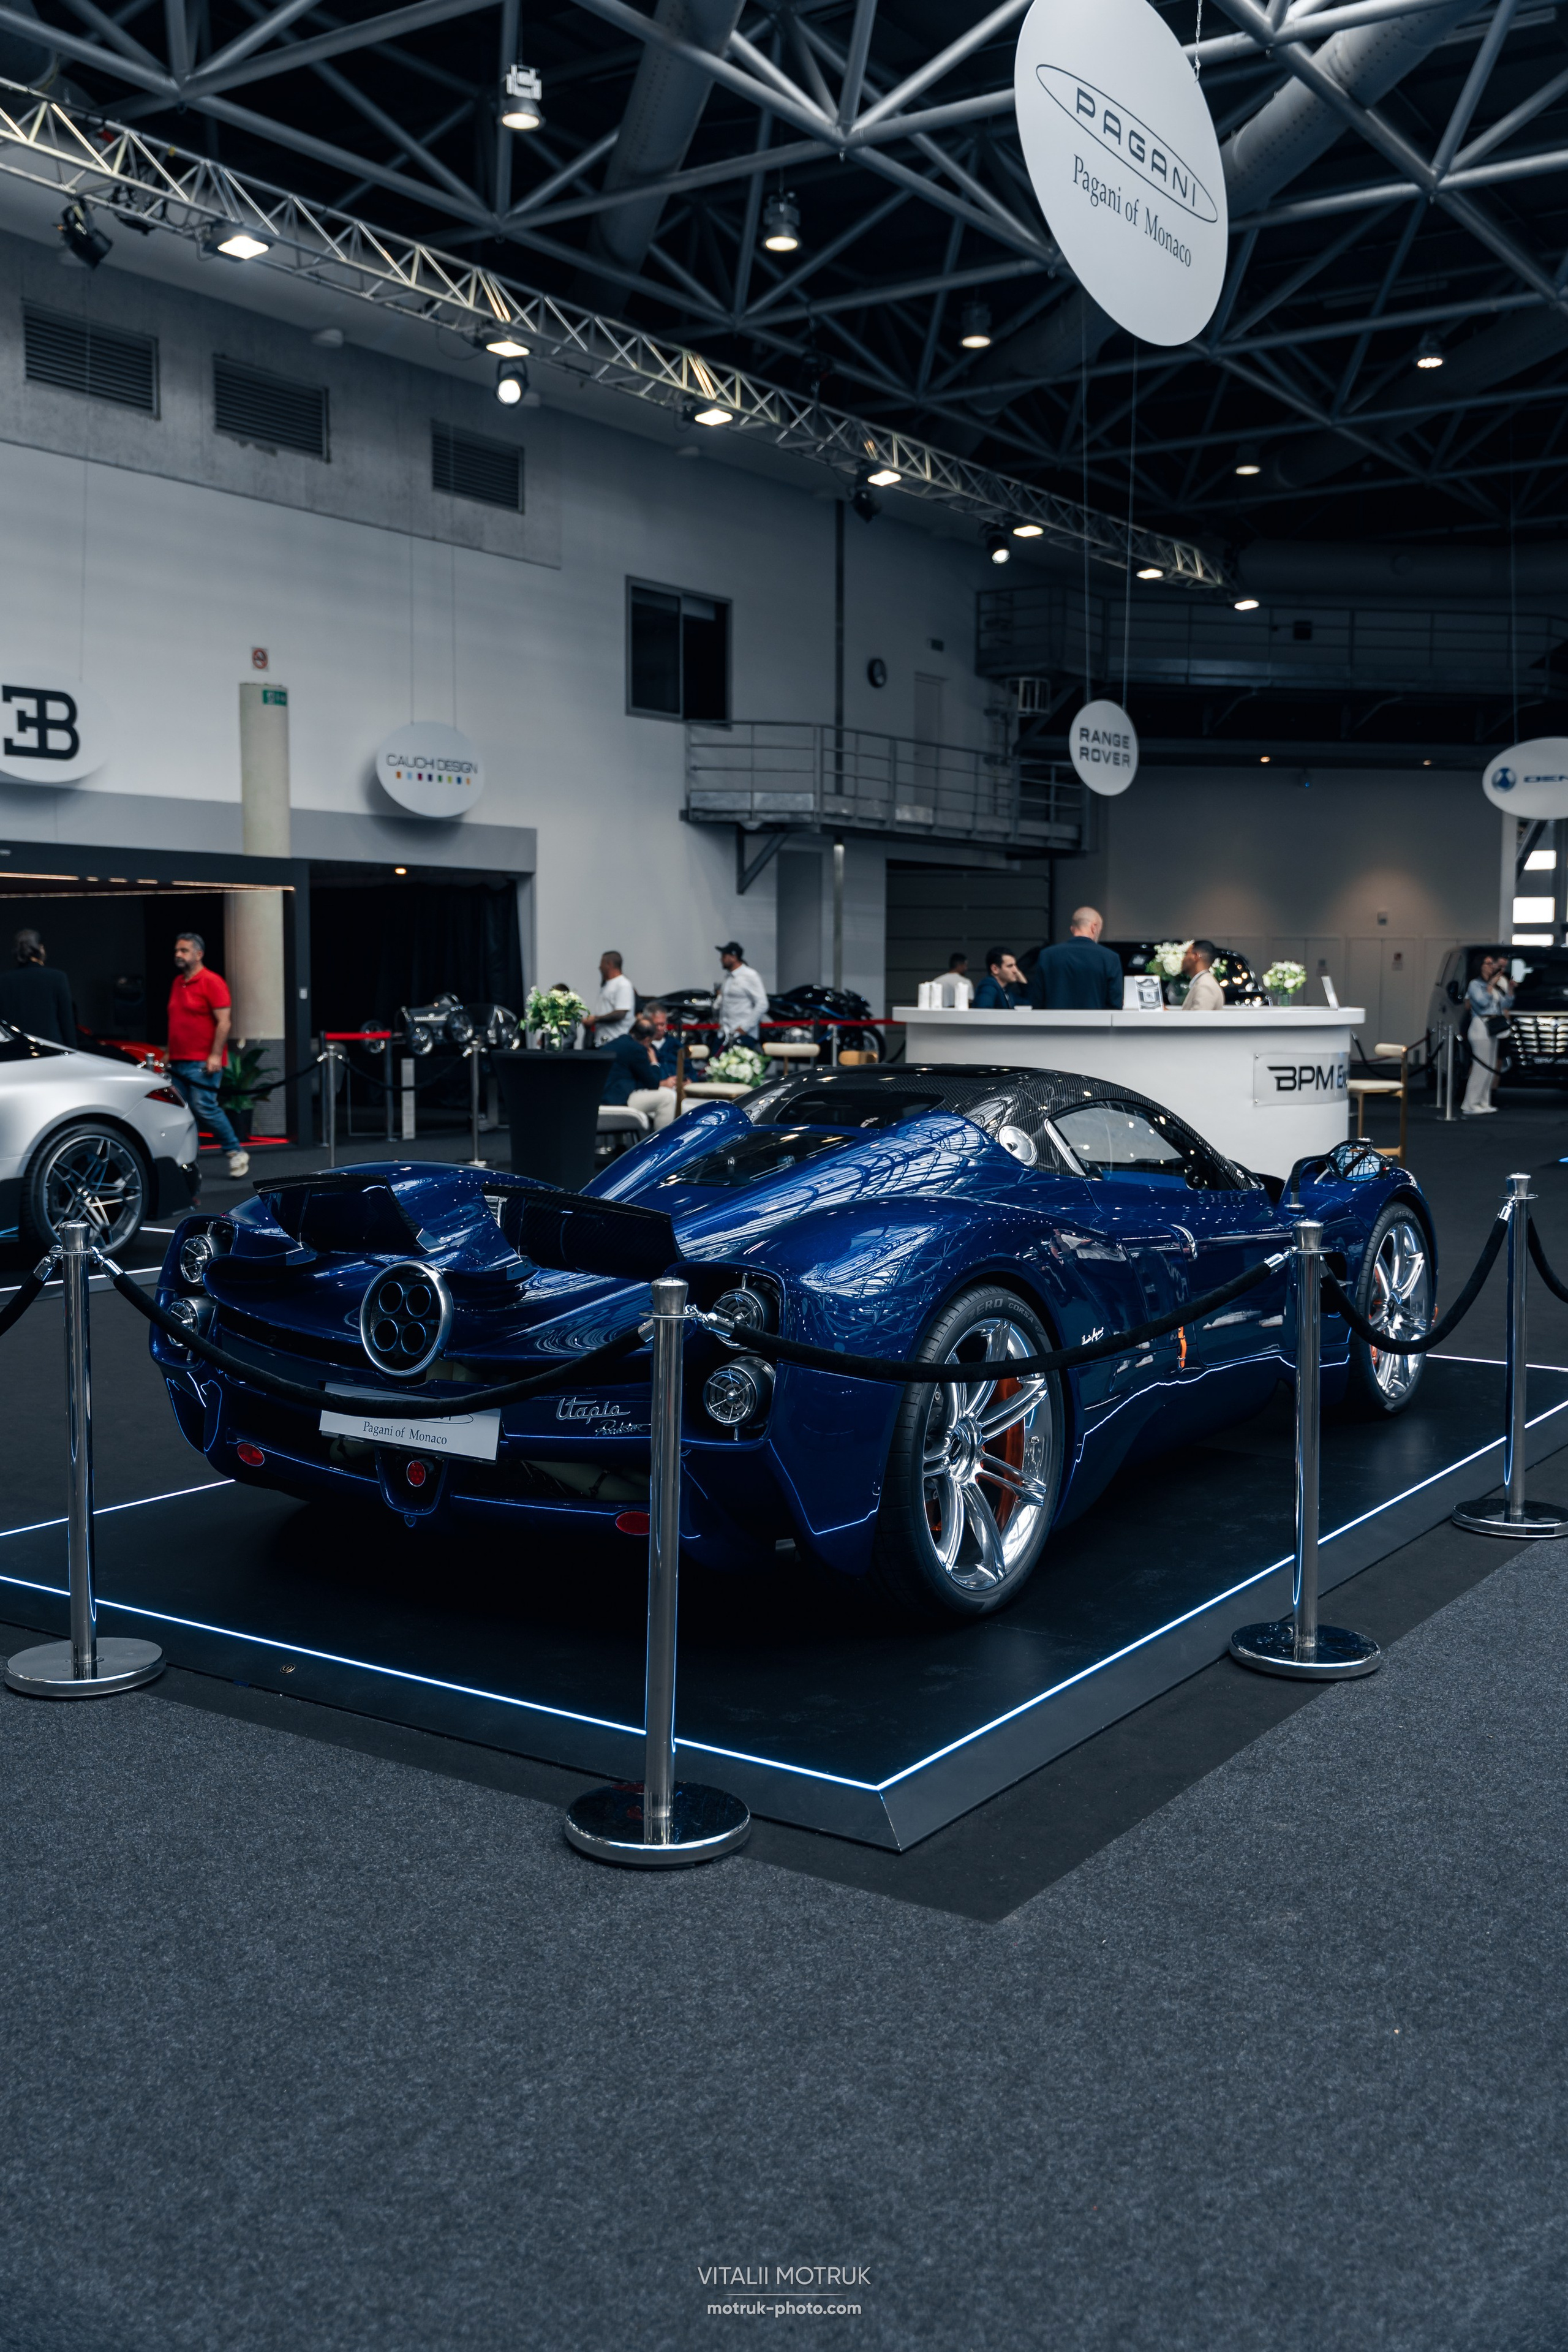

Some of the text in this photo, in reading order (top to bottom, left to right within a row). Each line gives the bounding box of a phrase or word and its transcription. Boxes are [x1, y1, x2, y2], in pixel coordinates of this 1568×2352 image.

[1076, 86, 1196, 207] PAGANI
[1072, 154, 1192, 268] Pagani of Monaco
[1079, 727, 1130, 750] RANGE
[436, 759, 478, 774] DESIGN
[1079, 746, 1130, 768] ROVER
[1267, 1065, 1334, 1091] BPM
[1008, 1302, 1034, 1323] CORSA
[363, 1420, 447, 1445] Pagani of Monaco
